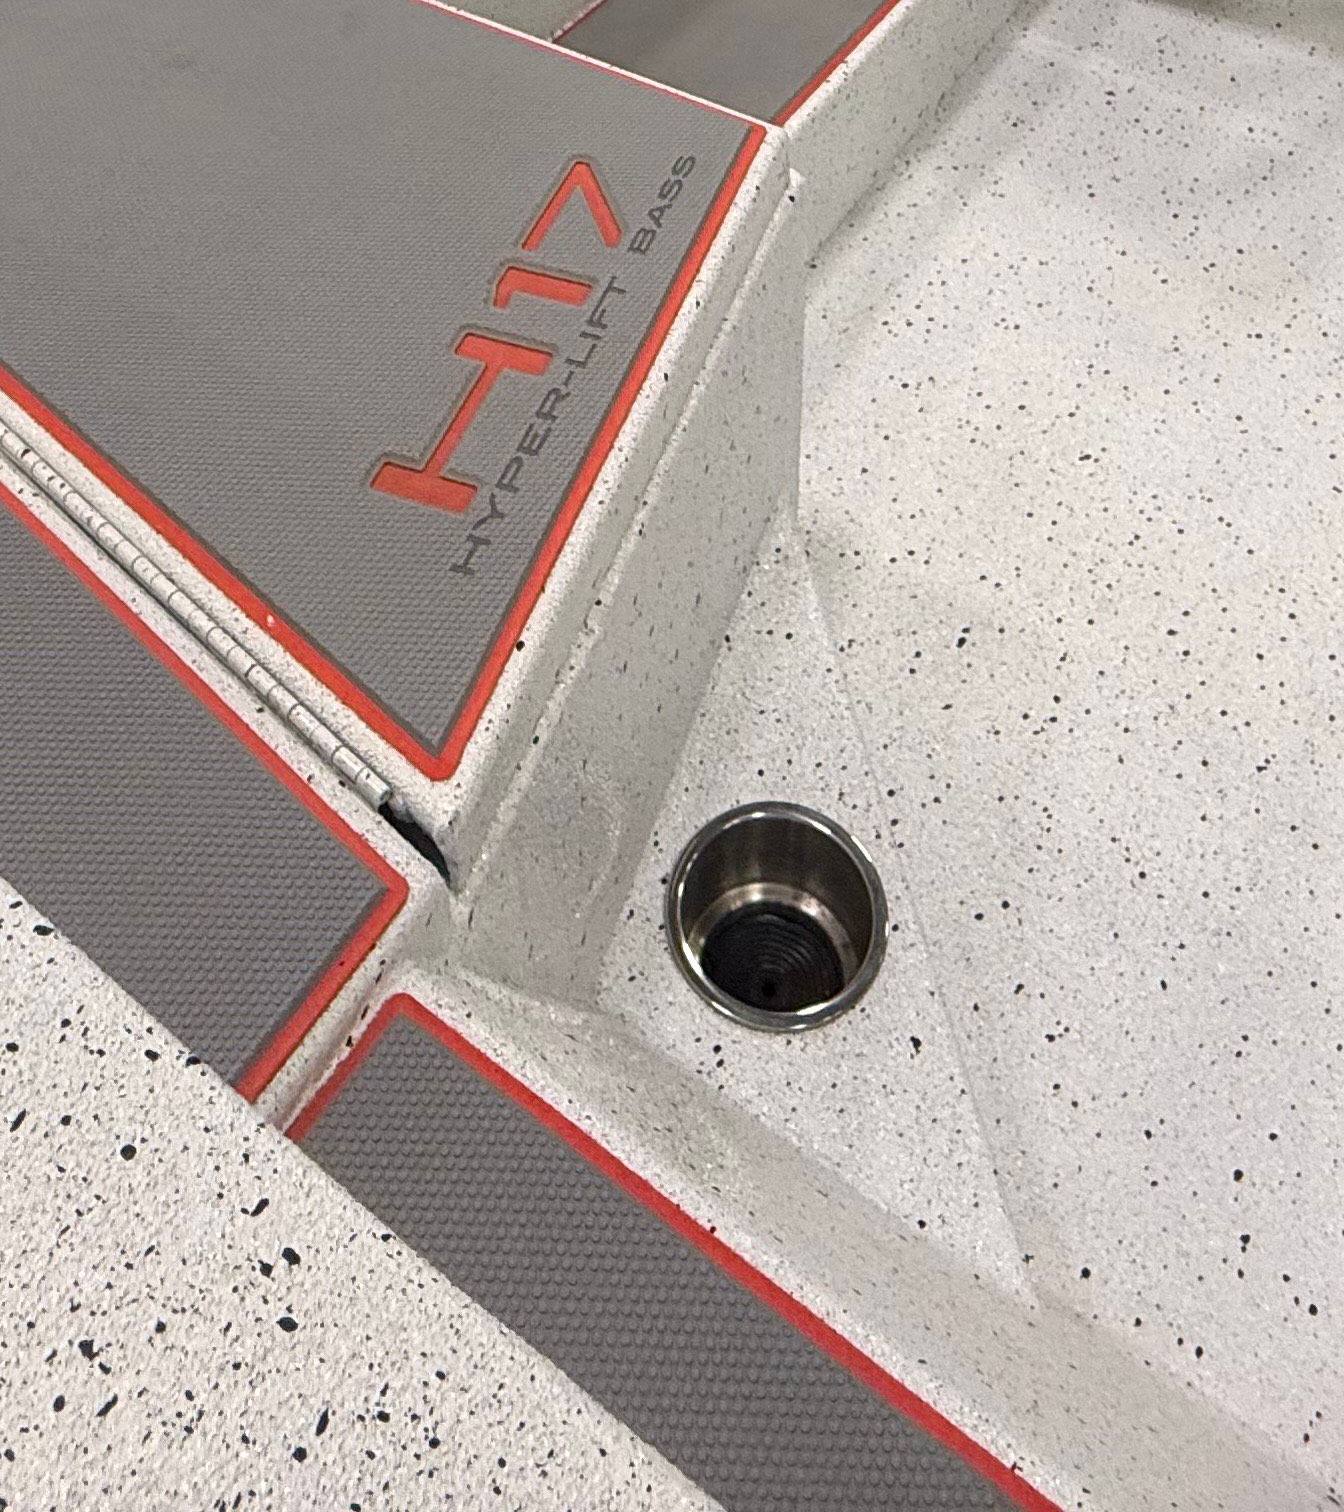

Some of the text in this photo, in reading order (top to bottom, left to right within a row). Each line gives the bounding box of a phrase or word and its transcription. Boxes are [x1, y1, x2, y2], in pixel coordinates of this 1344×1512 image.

[369, 161, 623, 514] H17
[450, 155, 697, 576] HYPER-LIFT BASS
